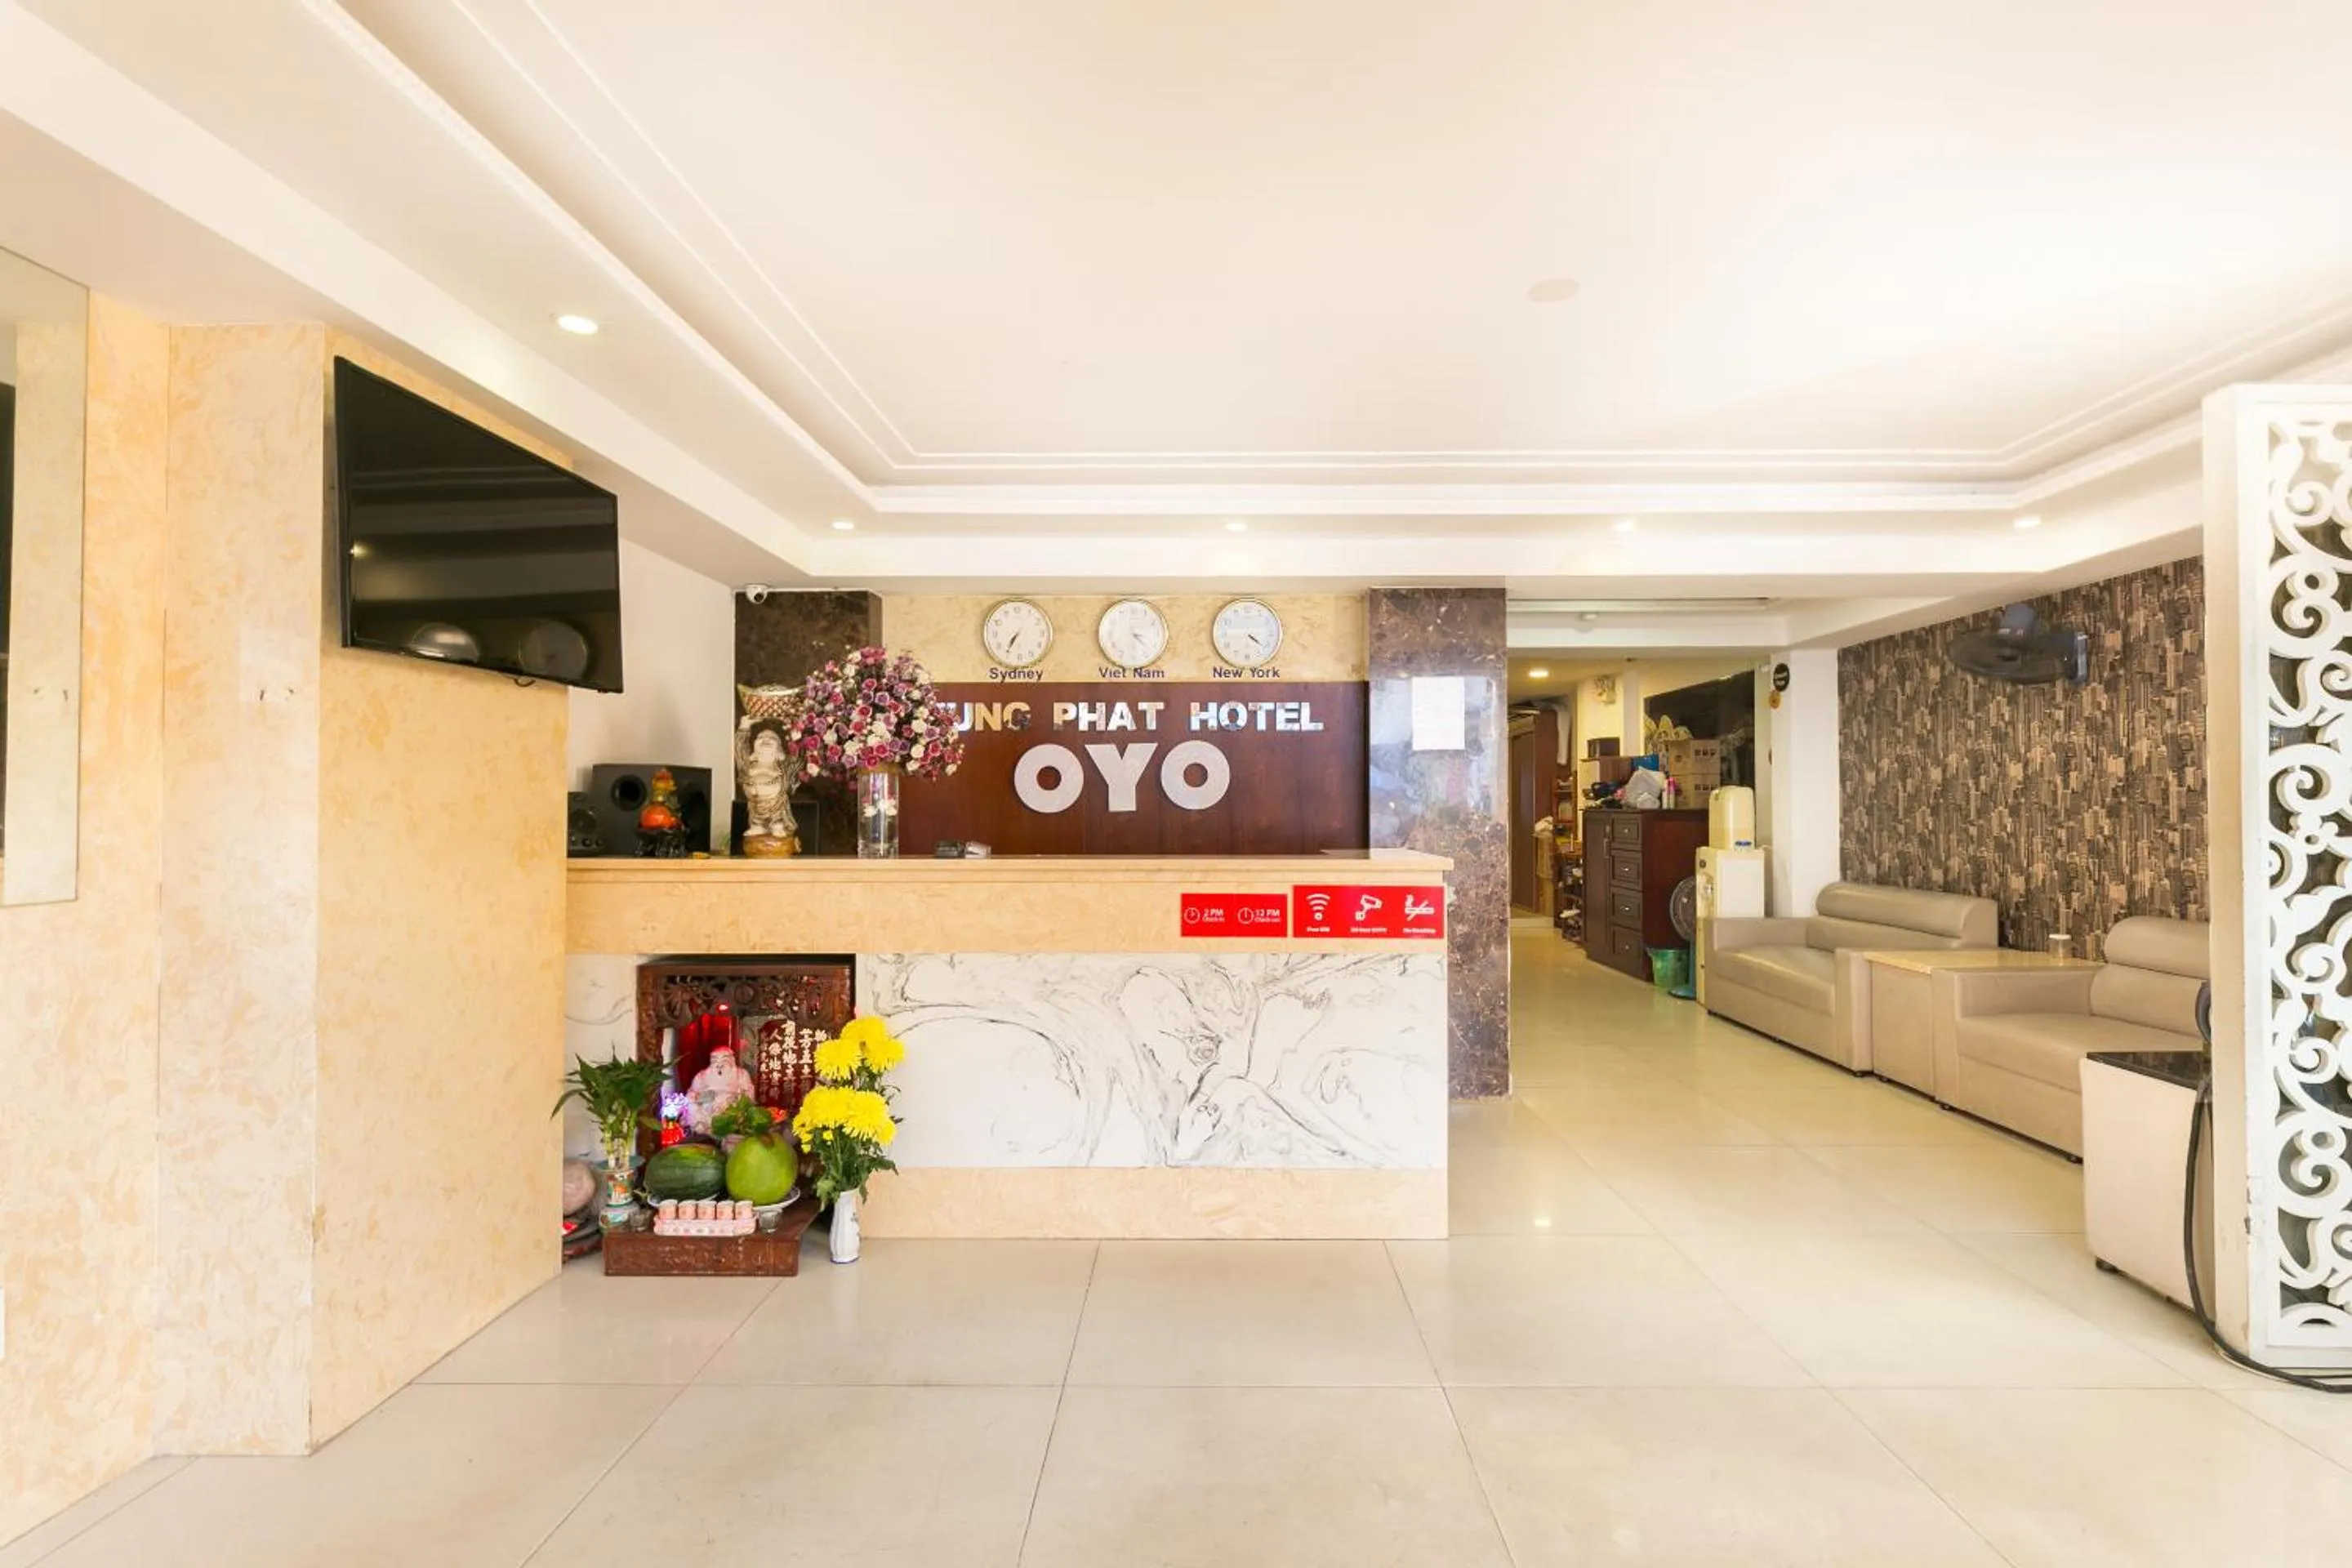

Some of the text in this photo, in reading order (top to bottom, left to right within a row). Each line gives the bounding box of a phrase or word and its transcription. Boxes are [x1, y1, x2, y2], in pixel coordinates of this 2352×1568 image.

[988, 667, 1044, 684] Sydney
[1098, 666, 1165, 679] Viet Nam
[1213, 666, 1281, 679] New York
[1053, 702, 1165, 732] PHAT
[1191, 702, 1325, 732] HOTEL
[1013, 740, 1231, 814] OYO
[1210, 908, 1224, 916] PM
[1266, 908, 1281, 916] PM
